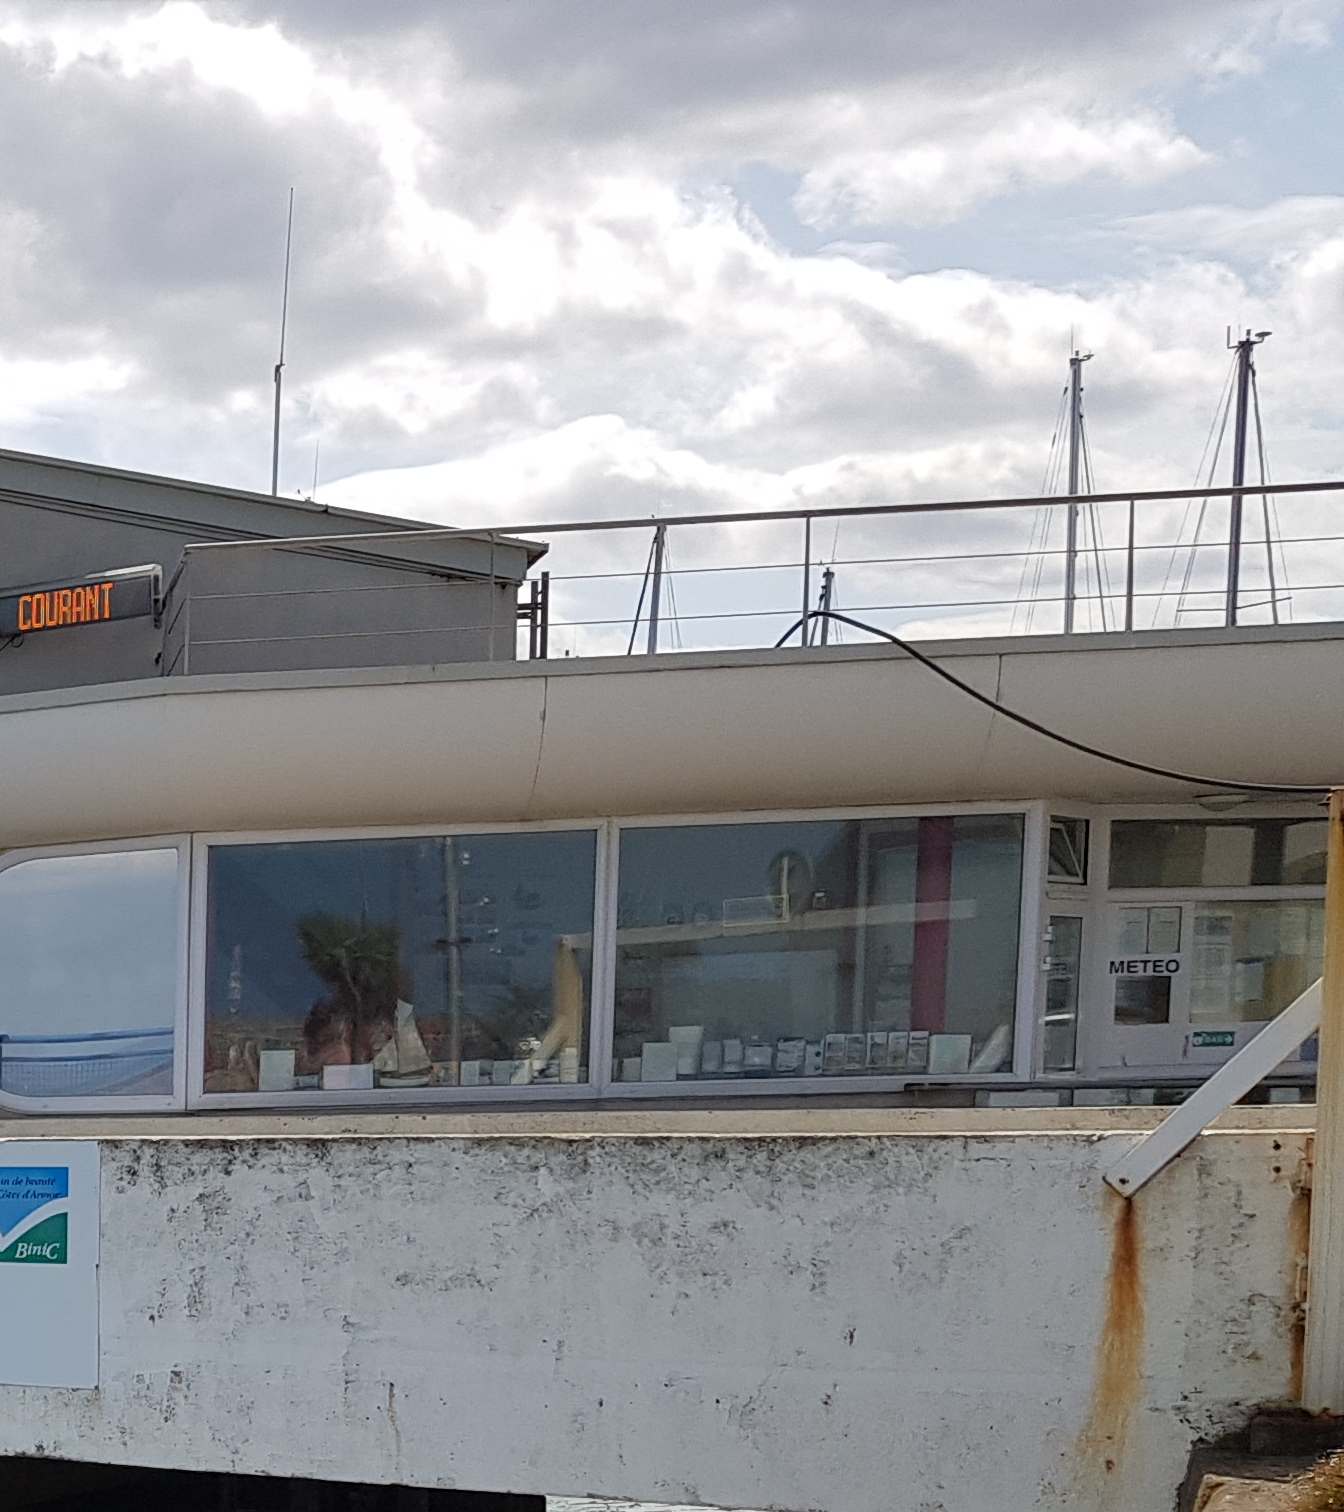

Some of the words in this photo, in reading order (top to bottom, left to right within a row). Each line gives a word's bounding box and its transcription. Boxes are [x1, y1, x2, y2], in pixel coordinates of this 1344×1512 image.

[18, 582, 115, 631] COURANT
[1109, 959, 1180, 974] METEO
[12, 1176, 23, 1186] de
[25, 1176, 56, 1186] beauté
